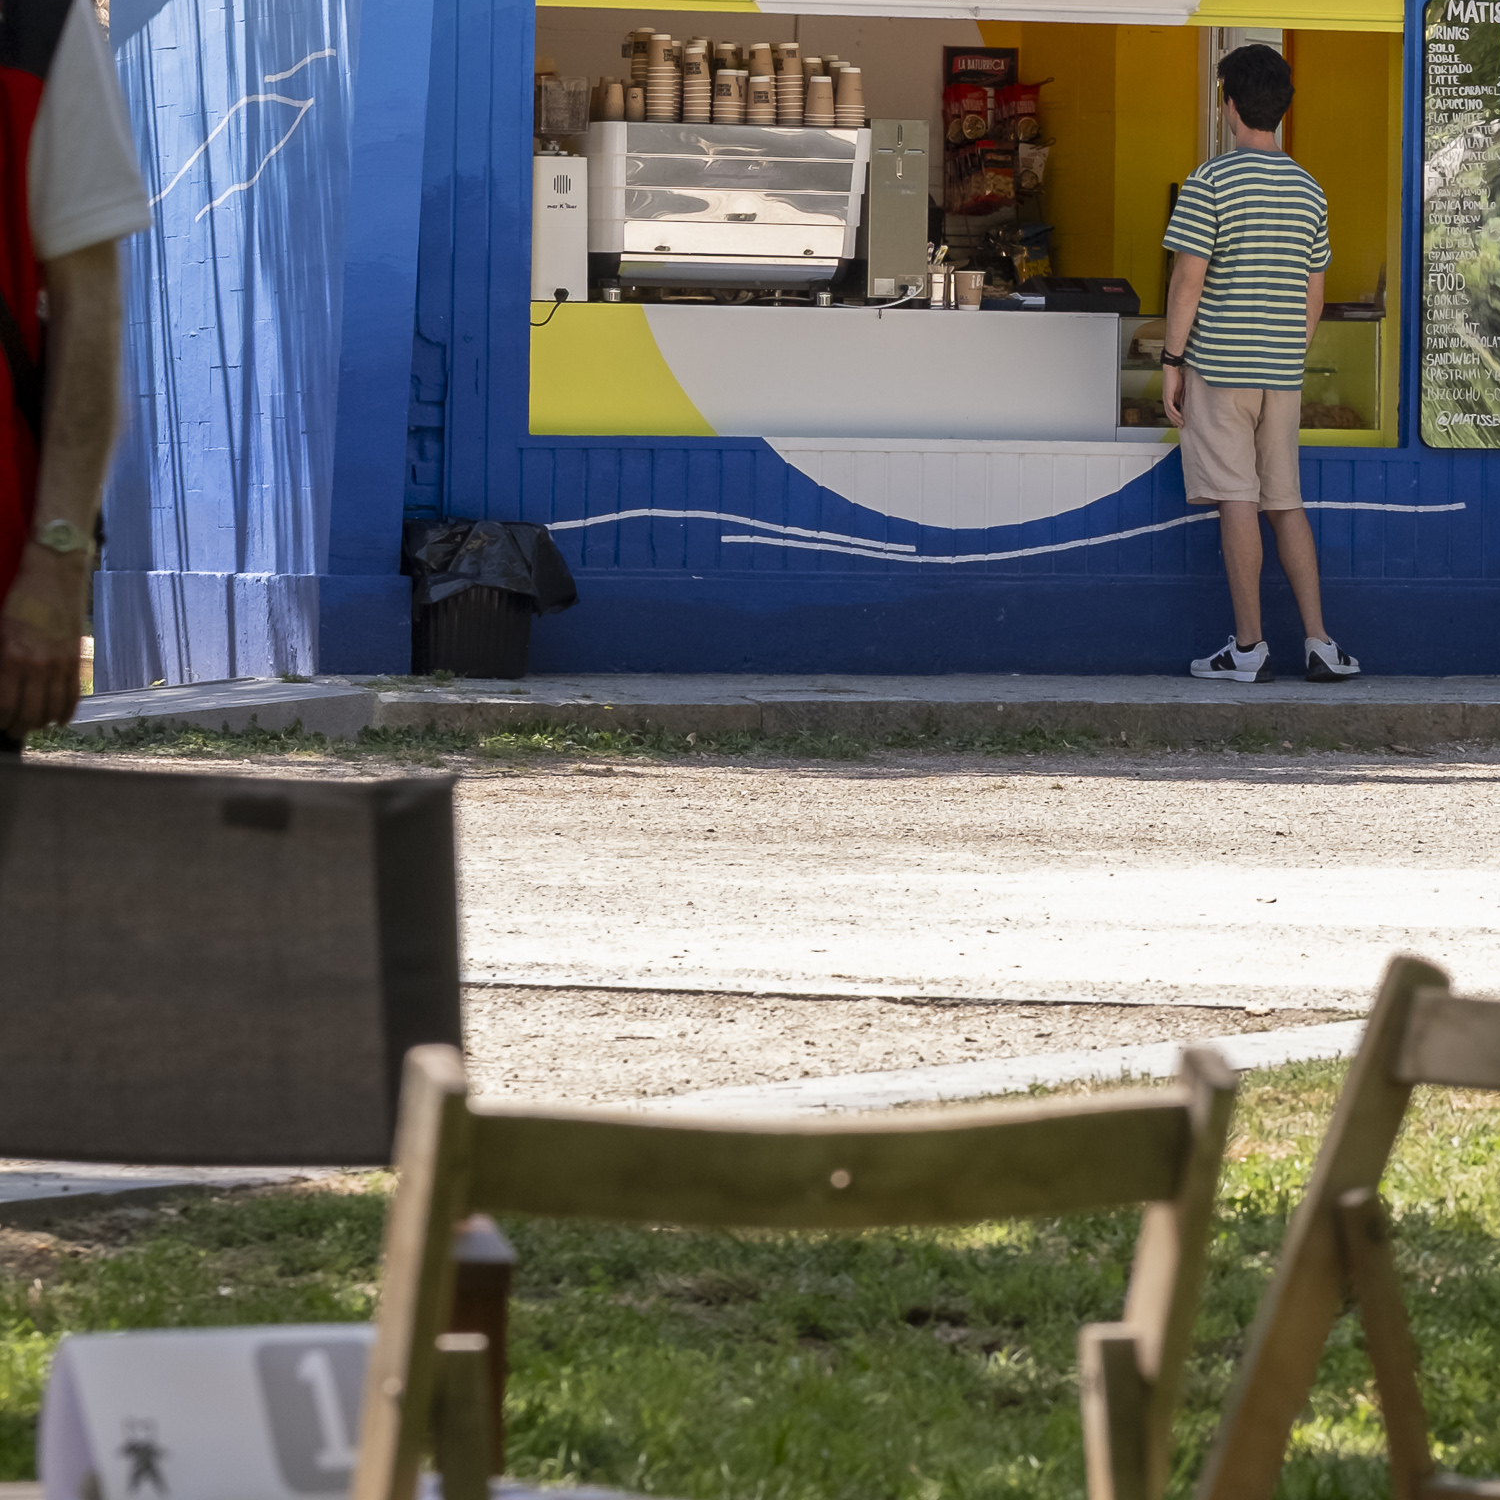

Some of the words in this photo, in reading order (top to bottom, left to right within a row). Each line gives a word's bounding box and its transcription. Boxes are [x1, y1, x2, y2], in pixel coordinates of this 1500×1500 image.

[1428, 26, 1470, 41] DRINKS
[1428, 43, 1456, 54] SOLO
[1428, 54, 1461, 64] DOBLE
[1428, 64, 1473, 75] CORTADO
[1429, 75, 1461, 85] LATTE
[1429, 86, 1457, 97] LATTE
[1458, 86, 1500, 97] CARAMEL
[1429, 98, 1484, 110] CAPUCCINO
[1427, 112, 1449, 124] FLAT
[1466, 125, 1495, 135] LATTE
[1429, 213, 1452, 224] COLD
[1453, 214, 1481, 224] BREW
[1445, 226, 1470, 236] TONIC
[1428, 262, 1456, 273] ZUMO
[1428, 273, 1466, 292] FOOD
[1426, 293, 1470, 307] COOKIES
[1425, 322, 1480, 335] CROISSNT
[1426, 337, 1448, 349] PAIN
[1426, 353, 1480, 366] SANDWICH
[1427, 386, 1481, 401] BIZCOCHO
